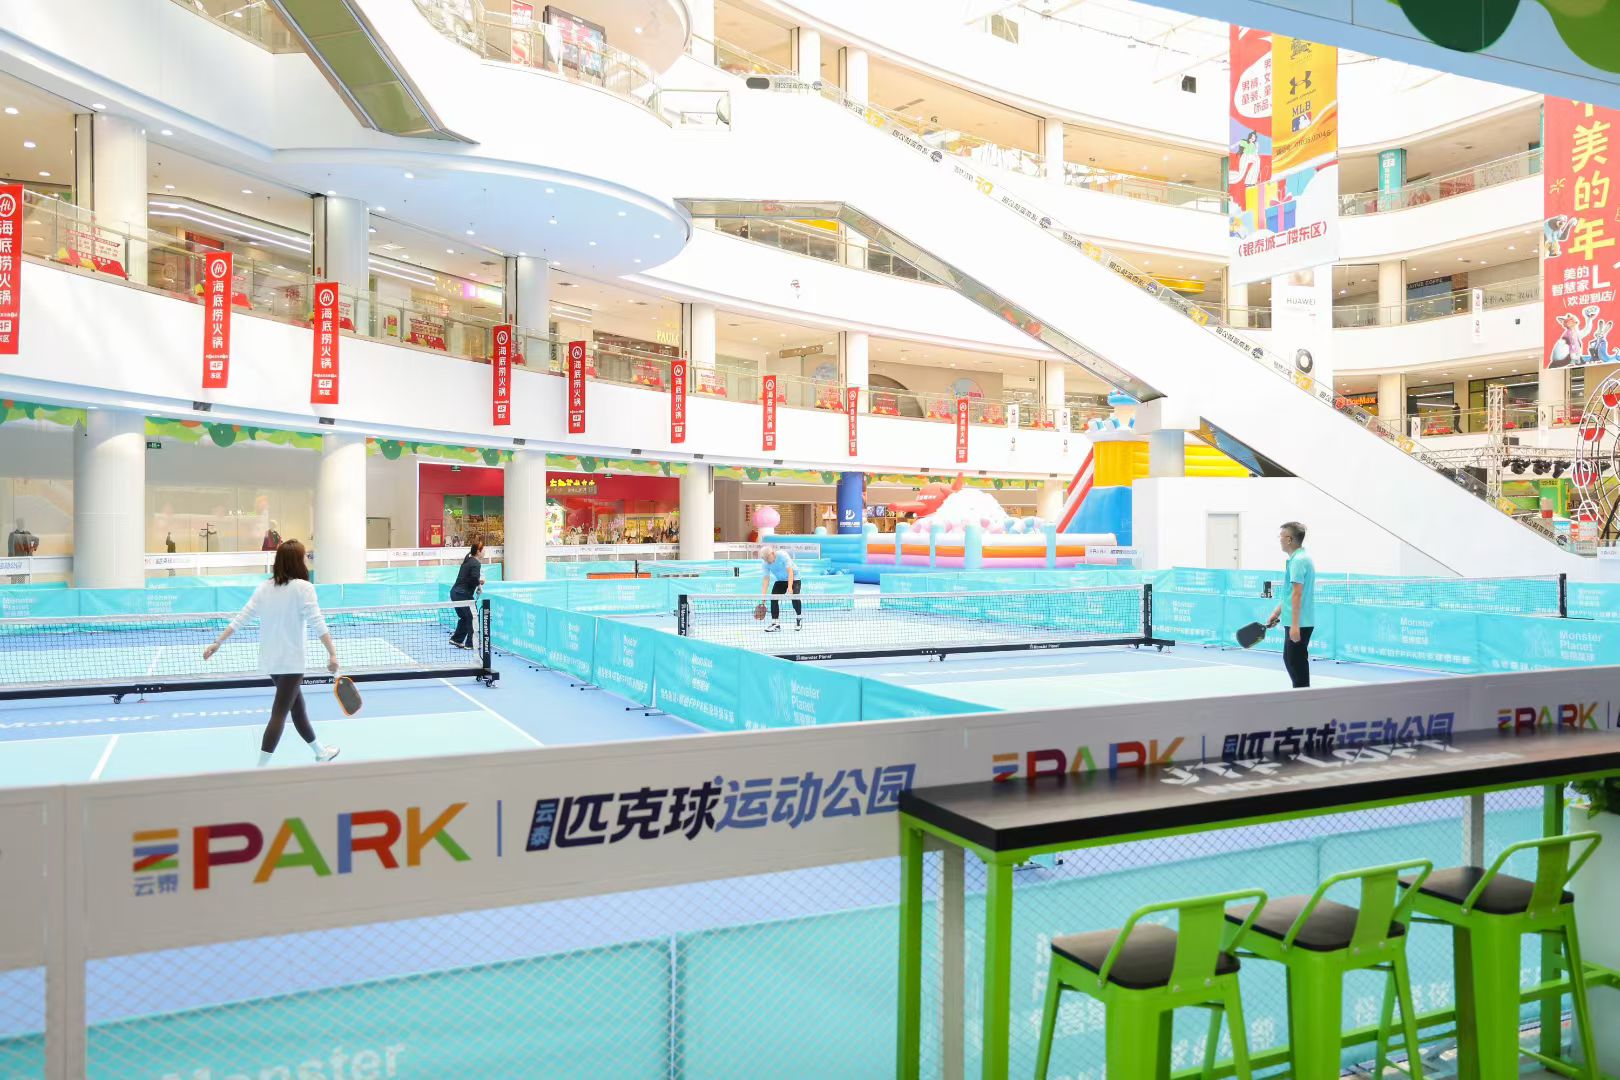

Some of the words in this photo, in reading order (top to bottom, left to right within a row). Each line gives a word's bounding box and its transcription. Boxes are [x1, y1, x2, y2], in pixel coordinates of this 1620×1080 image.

[1291, 100, 1311, 117] MLB
[1238, 221, 1328, 258] (银泰城二楼东区)
[1564, 266, 1589, 281] 美的
[1551, 280, 1590, 297] 智慧家
[1286, 297, 1316, 305] HUAWEI
[1567, 290, 1613, 306] 欢迎到店
[212, 280, 224, 349] 海底捞火锅
[321, 308, 333, 369] 海底捞火锅
[498, 347, 507, 396] 海底捞火锅
[1559, 630, 1602, 643] Monster
[1560, 640, 1593, 652] Planet
[791, 680, 821, 701] Monster
[555, 763, 917, 849] 匹克球运动公园
